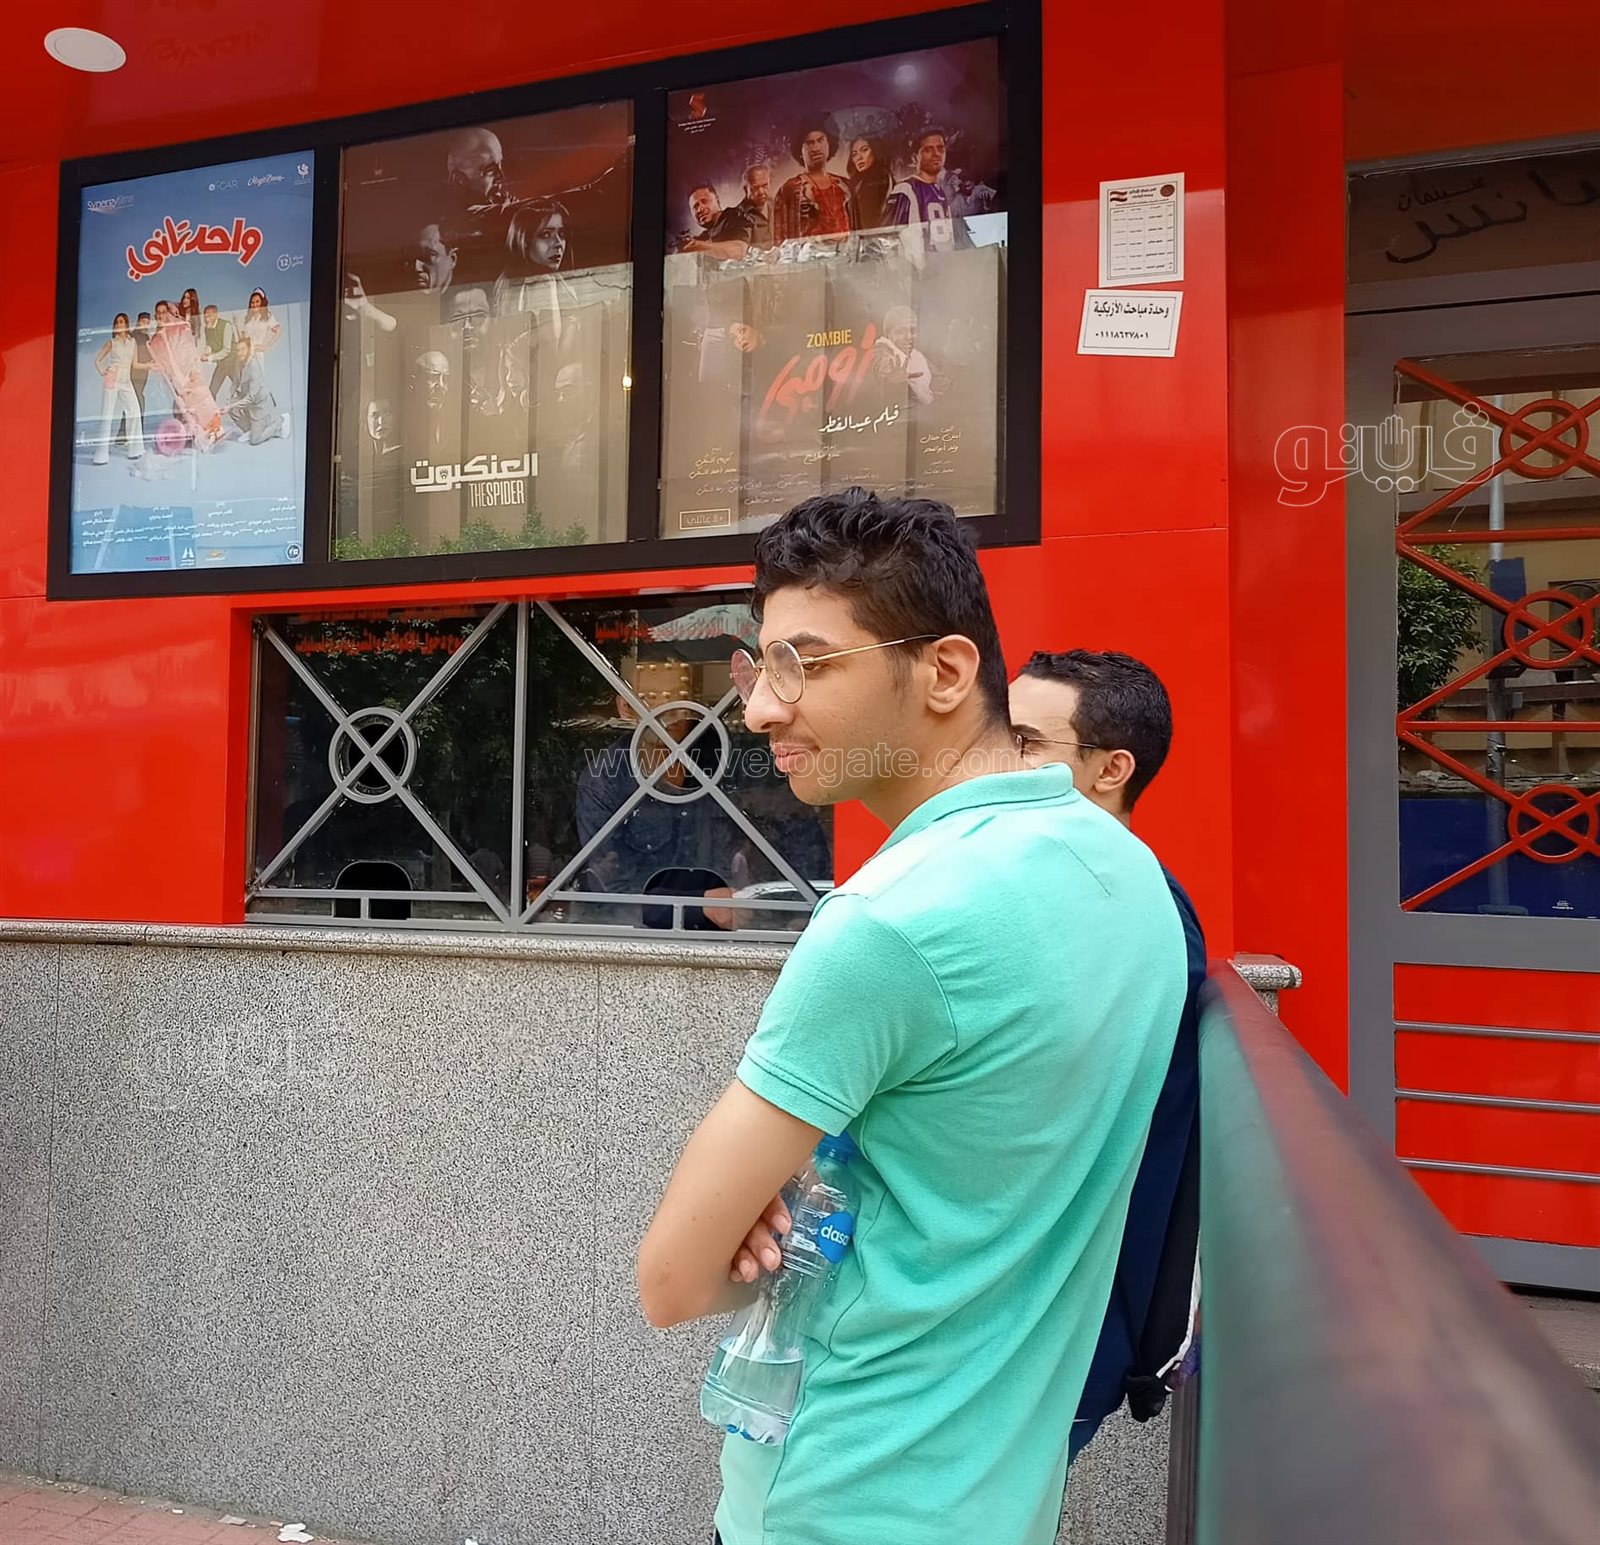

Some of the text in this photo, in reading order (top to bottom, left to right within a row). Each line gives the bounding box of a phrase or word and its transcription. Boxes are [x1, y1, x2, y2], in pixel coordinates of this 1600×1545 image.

[185, 217, 263, 267] واحد
[1123, 302, 1148, 318] مباحث
[1148, 302, 1169, 318] وحدة
[805, 329, 852, 349] ZOMBIE
[818, 414, 853, 433] الفطر
[873, 404, 899, 434] فيلم
[410, 452, 539, 494] العنكبوت
